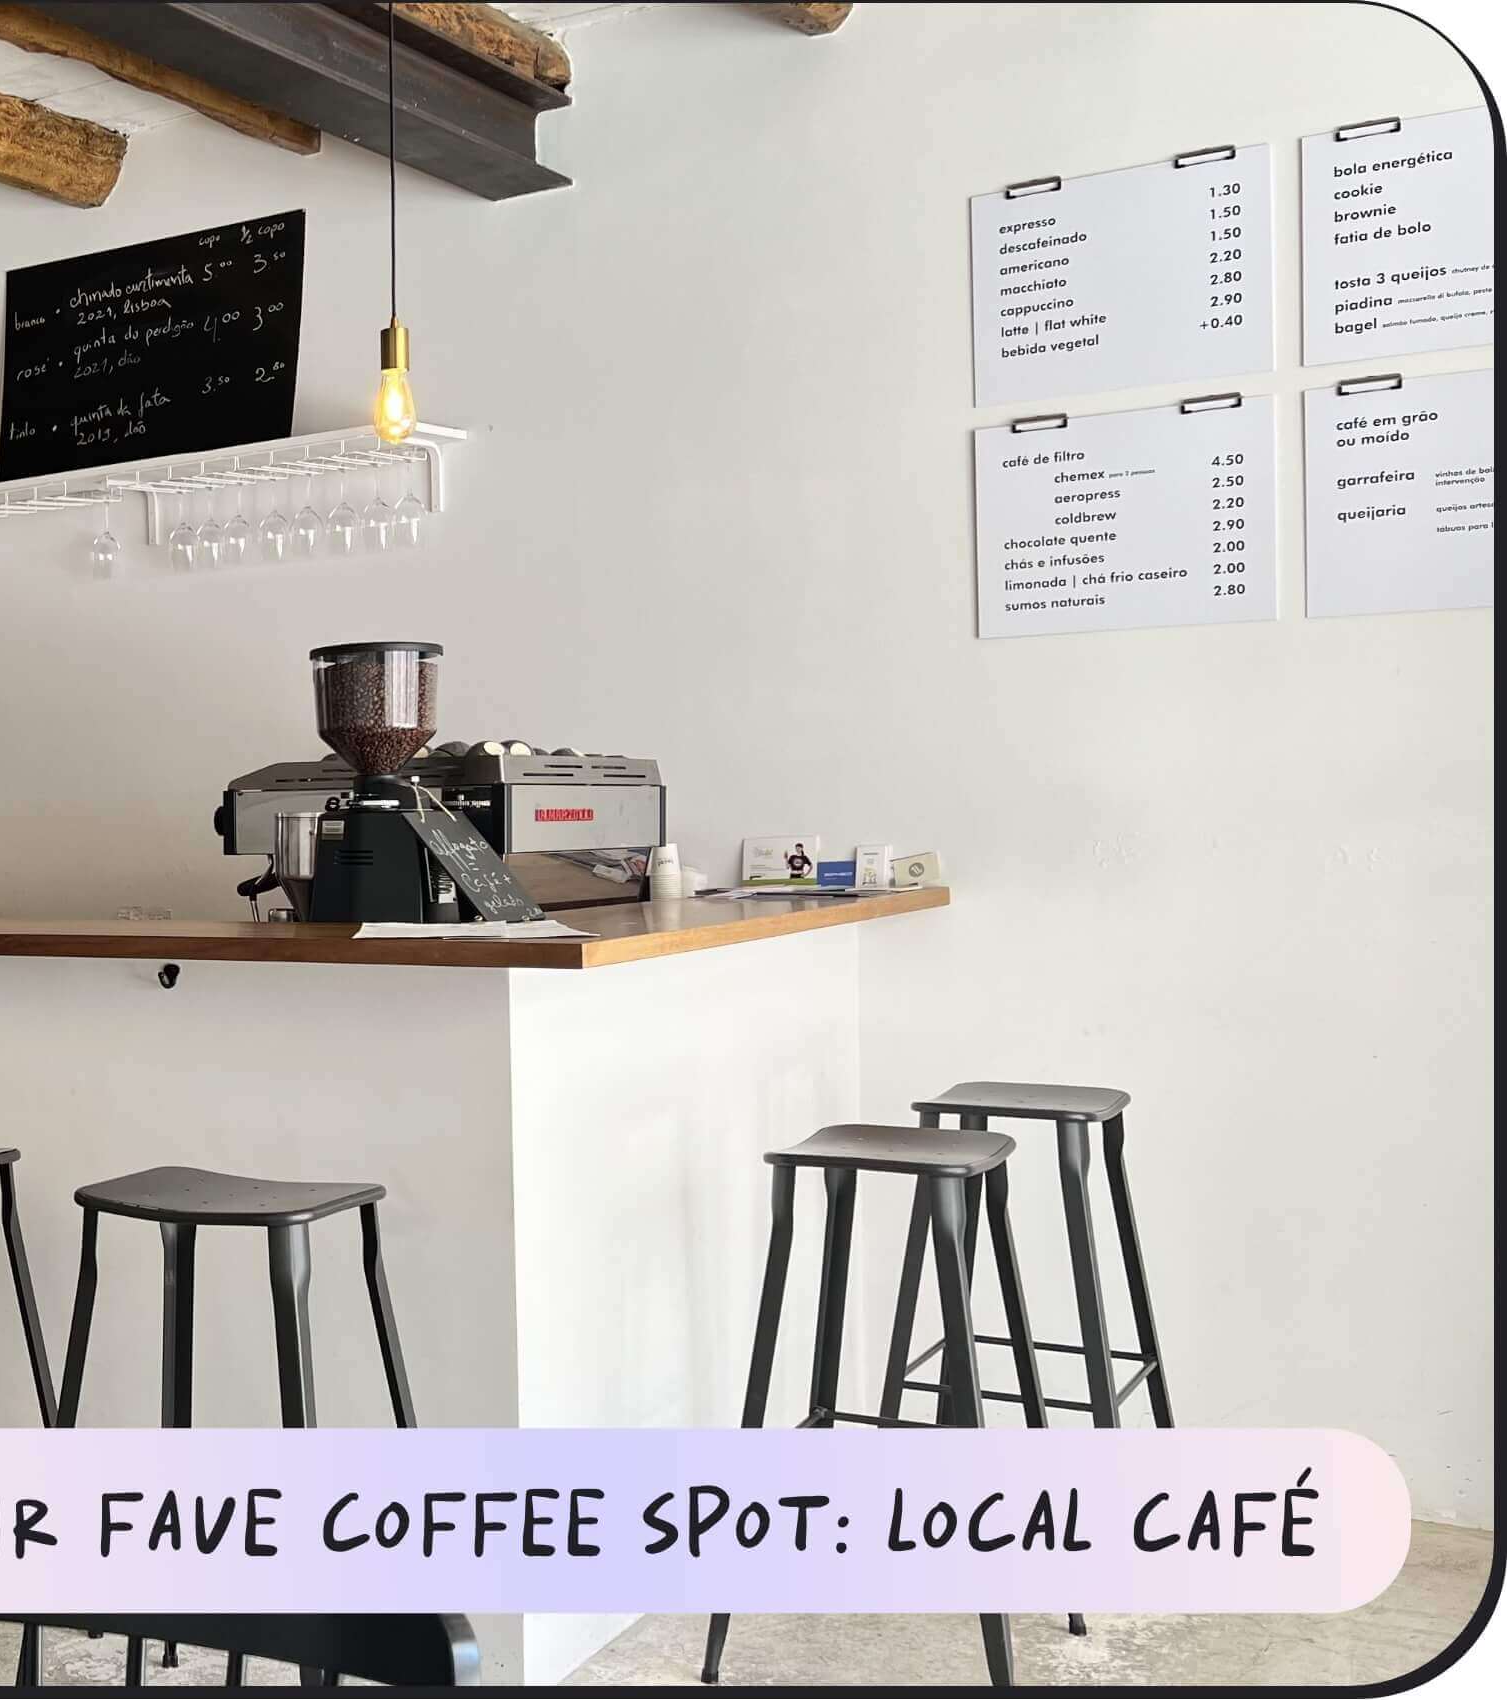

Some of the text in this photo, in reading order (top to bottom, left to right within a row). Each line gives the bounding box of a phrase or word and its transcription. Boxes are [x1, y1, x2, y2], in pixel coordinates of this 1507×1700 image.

[1334, 151, 1452, 177] bola energética
[1334, 183, 1382, 200] cookie
[999, 183, 1240, 234] expresso 1.30
[1335, 204, 1396, 222] brownie
[199, 235, 221, 249] copo
[258, 222, 285, 239] copo
[1000, 205, 1240, 254] descafeinado 1.50
[1334, 222, 1431, 245] fatia de bolo
[1000, 227, 1241, 275] americano 1.50
[1001, 249, 1241, 296] macchiato 2.20
[1335, 277, 1370, 289] tosta
[1377, 273, 1385, 284] 3
[1391, 266, 1446, 284] queijos
[1001, 271, 1241, 317] cappuccino 2.80
[1335, 297, 1392, 315] piadina
[14, 311, 46, 331] branco
[1002, 326, 1029, 337] latte
[1045, 320, 1065, 331] flat
[1070, 314, 1106, 327] white
[1211, 293, 1242, 307] 2.90
[1335, 318, 1376, 334] bagel
[1002, 315, 1242, 358] bebida vegetal +0.40
[16, 357, 49, 381] rosé
[73, 326, 116, 364] quinta
[124, 324, 139, 340] do
[9, 421, 36, 441] tinto
[70, 404, 113, 437] quinta
[1336, 411, 1438, 430] café em grão
[1337, 430, 1409, 447] ou moído
[1002, 451, 1084, 468] café de filtro
[1054, 471, 1104, 483] chemex
[1212, 454, 1243, 466] 4.50
[1055, 475, 1243, 503] aeropress 2.50
[1337, 470, 1414, 489] garrafeira
[1436, 477, 1485, 486] intervenção
[1055, 497, 1244, 525] coldbrew 2.20
[1338, 505, 1405, 523] queijaria
[1004, 519, 1244, 550] chocolate quente 2.90
[1005, 559, 1033, 570] chás
[1050, 554, 1104, 567] infusões
[1213, 541, 1244, 553] 2.00
[1005, 577, 1066, 590] limonada
[1082, 573, 1105, 584] chá
[1110, 571, 1133, 583] frio
[1138, 568, 1187, 580] caseiro
[1214, 562, 1245, 574] 2.00
[1005, 584, 1245, 611] sumos naturais 2.80
